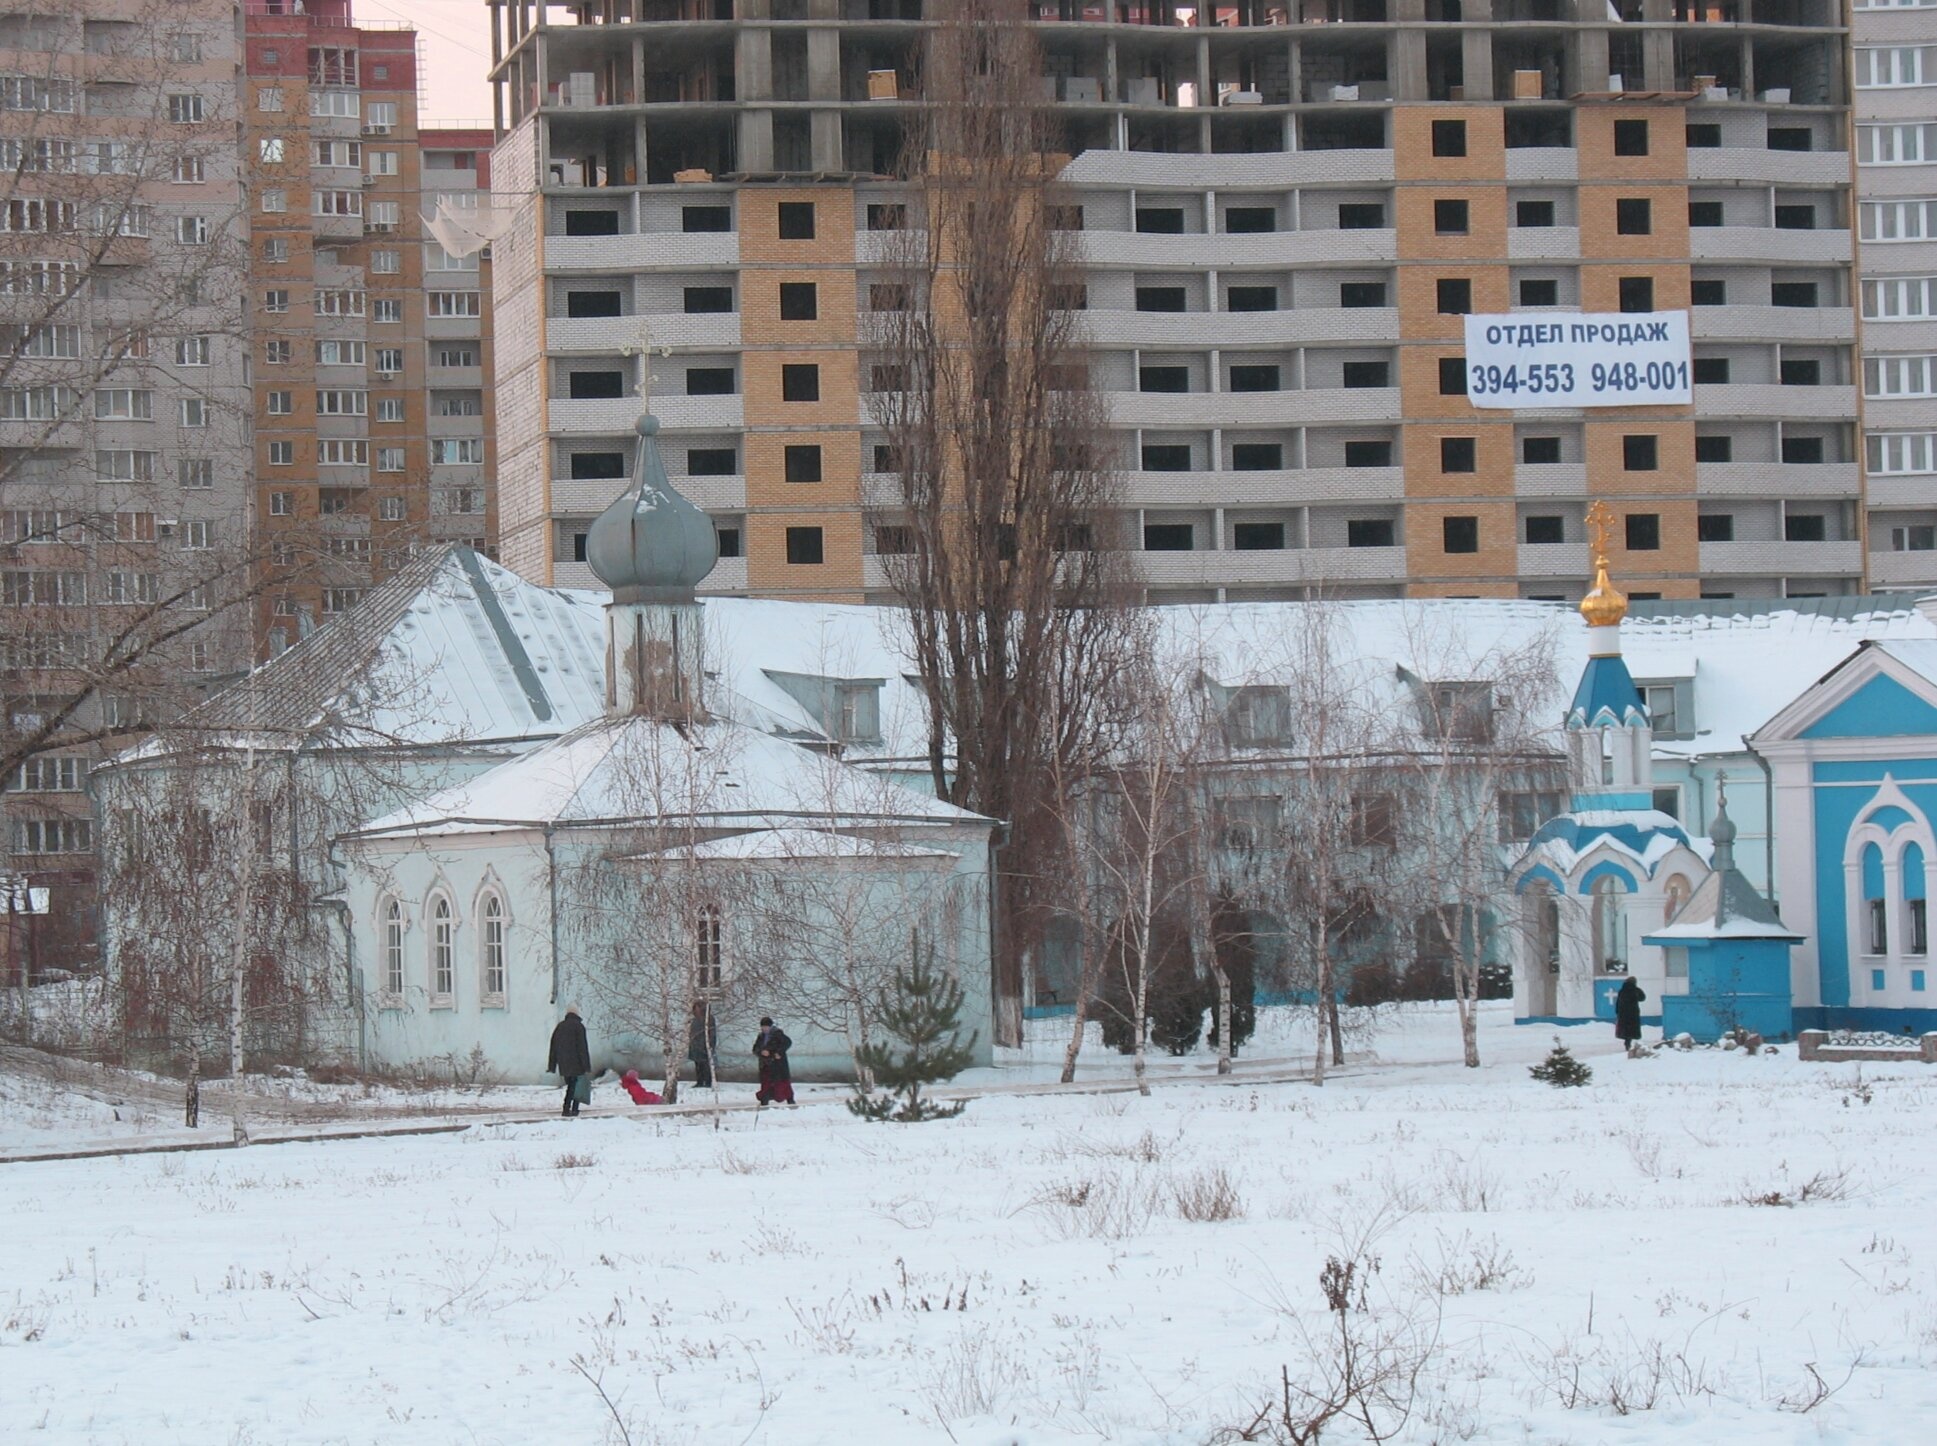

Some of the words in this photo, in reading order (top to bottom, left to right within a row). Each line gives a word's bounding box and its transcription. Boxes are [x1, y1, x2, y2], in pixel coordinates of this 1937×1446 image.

[1486, 324, 1563, 347] ОТДЕЛ
[1571, 322, 1669, 345] ПРОДАЖ
[1472, 363, 1574, 394] 394-553
[1591, 361, 1688, 391] 948-001
